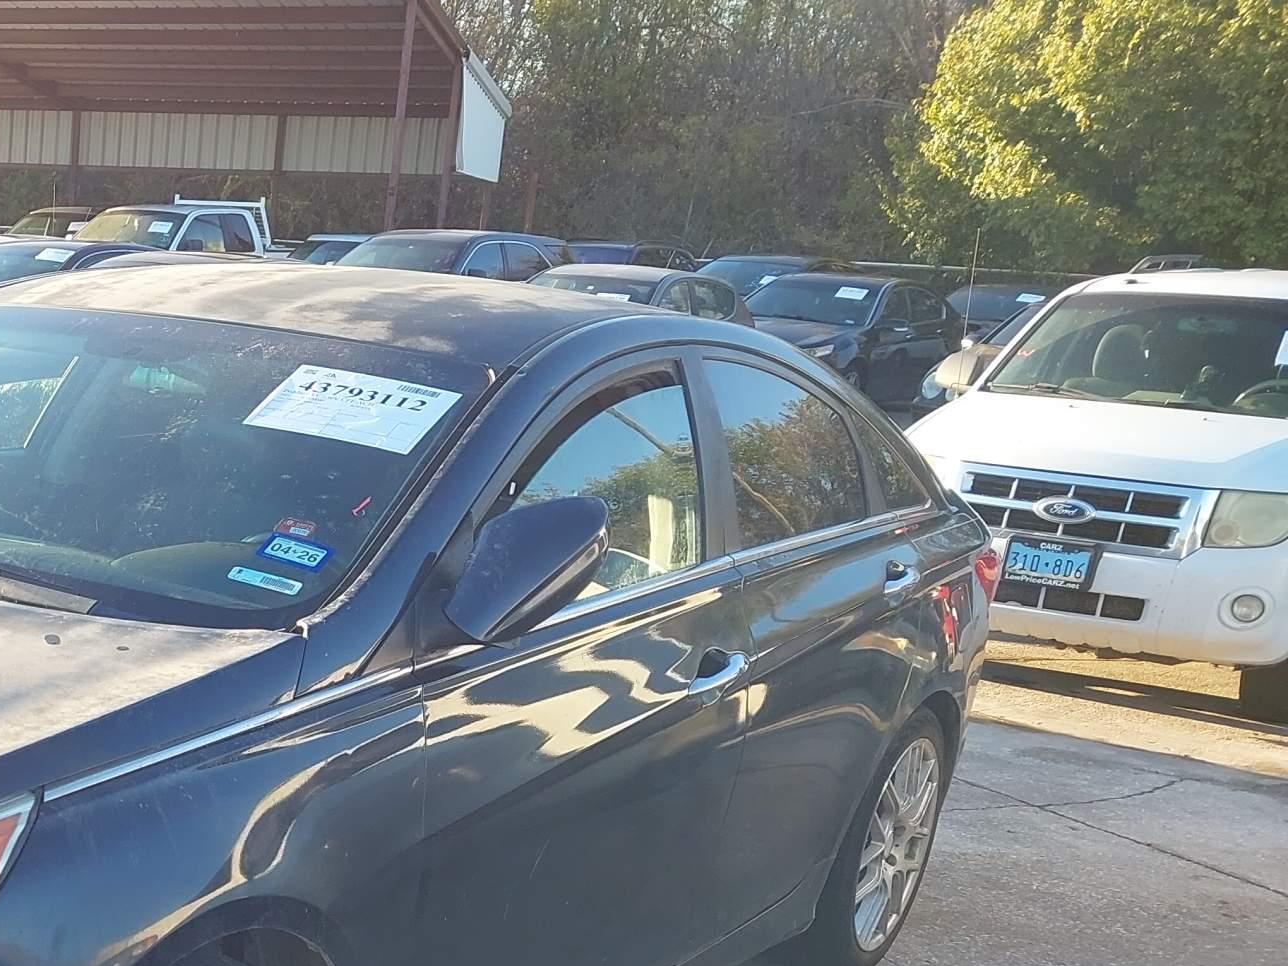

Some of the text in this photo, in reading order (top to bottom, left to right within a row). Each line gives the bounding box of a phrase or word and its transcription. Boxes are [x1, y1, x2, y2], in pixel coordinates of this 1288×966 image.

[298, 380, 428, 412] 43793112
[1049, 503, 1079, 516] Ford
[1040, 542, 1064, 551] CARZ
[1004, 572, 1081, 590] LowPriceCARZ.net
